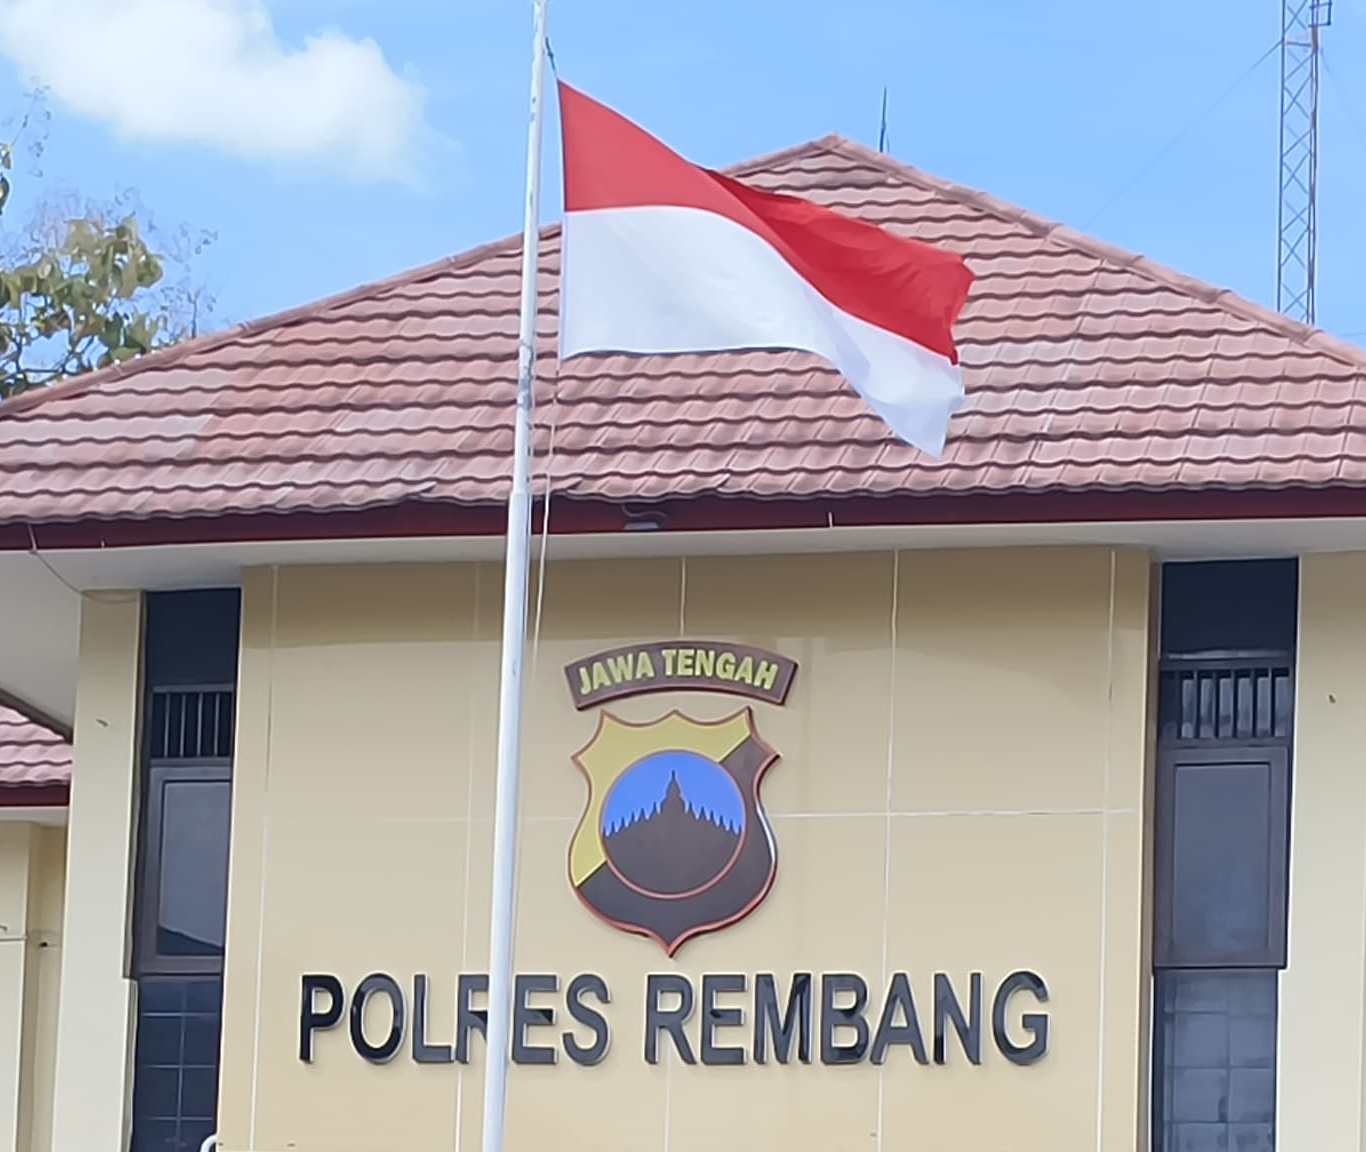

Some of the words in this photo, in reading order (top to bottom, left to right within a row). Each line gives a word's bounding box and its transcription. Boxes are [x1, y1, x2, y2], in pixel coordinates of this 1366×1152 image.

[578, 650, 655, 695] JAWA
[663, 648, 779, 690] TENGAH
[298, 972, 613, 1066] POLRES
[643, 970, 1050, 1067] REMBANG
